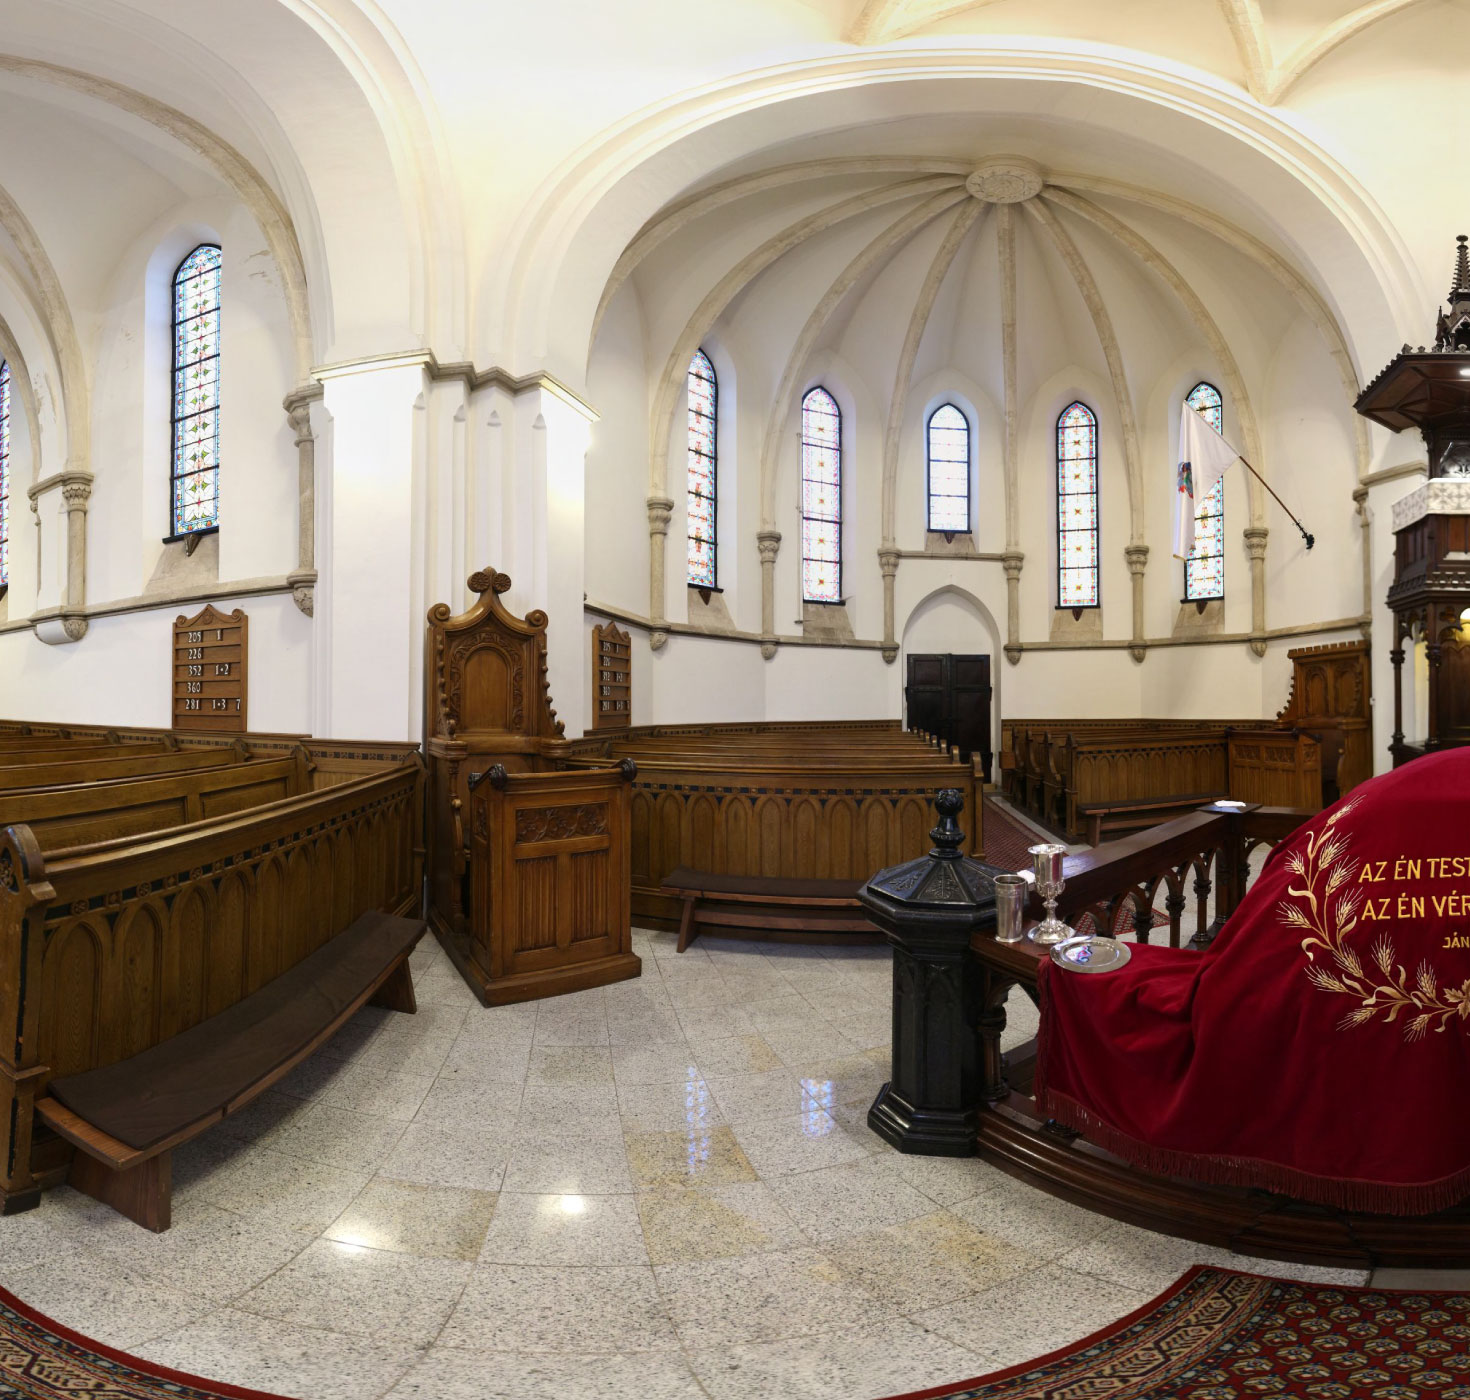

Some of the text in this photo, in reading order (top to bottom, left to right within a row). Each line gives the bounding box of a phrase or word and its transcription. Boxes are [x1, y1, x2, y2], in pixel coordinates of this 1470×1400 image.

[188, 629, 222, 643] 205 1
[188, 648, 202, 660] 226
[188, 665, 202, 676] 352
[187, 682, 201, 693] 360
[185, 699, 200, 710] 281
[1358, 861, 1388, 883] AZ
[1394, 854, 1421, 880] ÉN
[1361, 898, 1391, 921] AZ
[1397, 892, 1425, 919] ÉN
